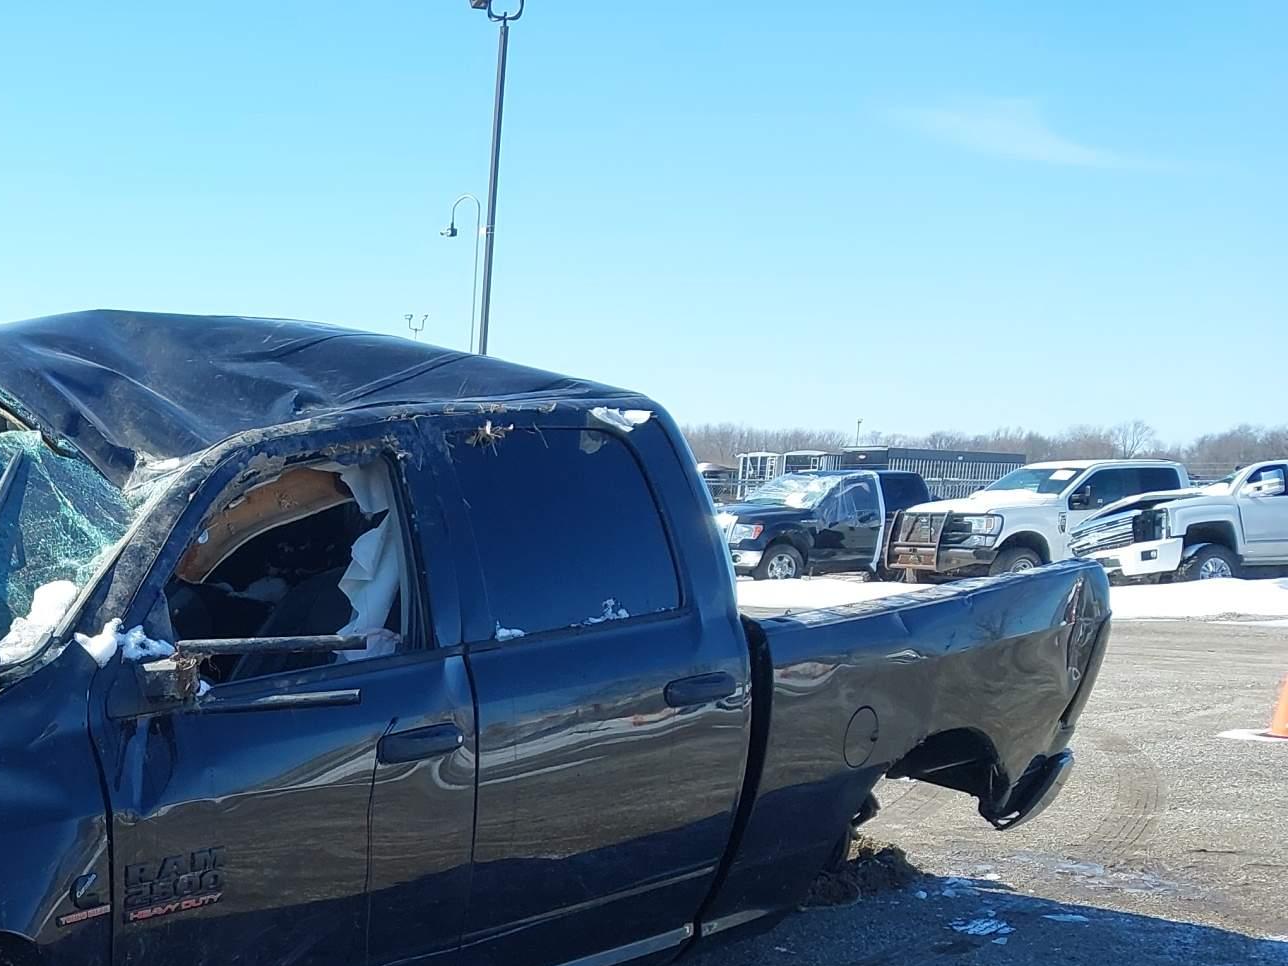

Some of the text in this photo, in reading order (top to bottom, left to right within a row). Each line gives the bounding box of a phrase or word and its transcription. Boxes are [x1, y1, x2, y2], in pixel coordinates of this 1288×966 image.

[124, 845, 224, 887] RAM
[128, 892, 224, 922] HEAVY DUTY
